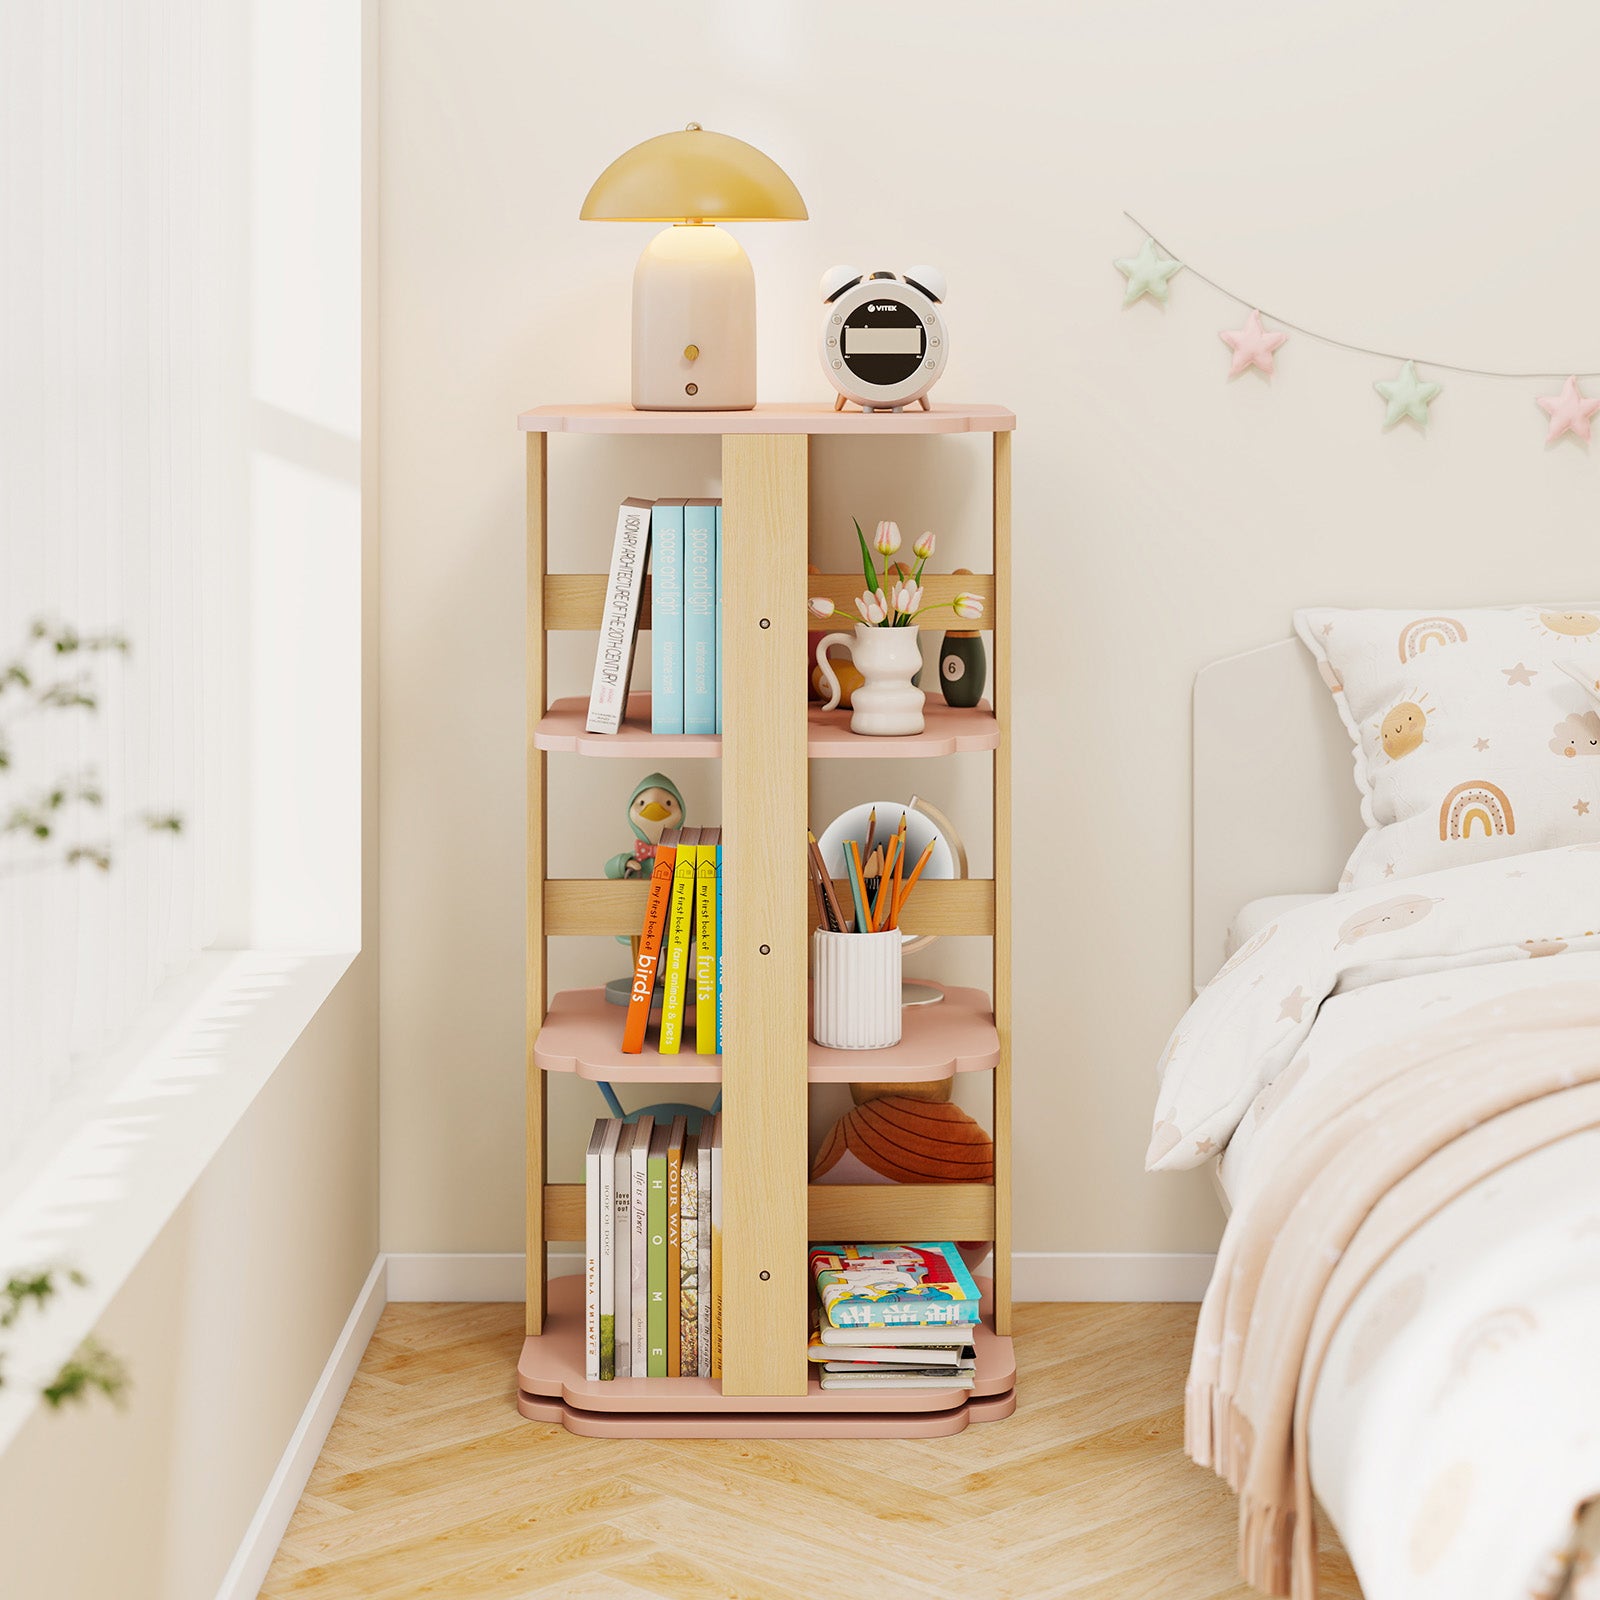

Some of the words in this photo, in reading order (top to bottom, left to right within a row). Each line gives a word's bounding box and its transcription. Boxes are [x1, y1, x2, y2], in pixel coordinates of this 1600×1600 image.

[622, 514, 641, 547] VISIONARY
[657, 528, 676, 563] space
[689, 528, 708, 563] space
[614, 547, 635, 602] ARCHITECTURE
[660, 566, 680, 589] and
[692, 566, 712, 589] and
[612, 601, 629, 612] OF
[656, 592, 680, 616] light
[688, 592, 712, 616] light
[610, 611, 627, 628] THE
[607, 627, 625, 650] 20TH
[601, 648, 622, 687] CENTURY
[948, 662, 956, 674] 6
[652, 885, 661, 897] my
[677, 884, 685, 894] my
[700, 885, 707, 897] my
[650, 899, 660, 918] first
[676, 897, 685, 914] first
[701, 899, 709, 917] first
[647, 921, 656, 939] book
[675, 917, 684, 934] book
[645, 941, 652, 950] of
[675, 936, 681, 944] of
[702, 942, 709, 950] of
[672, 947, 682, 969] farm
[632, 954, 656, 1002] birds
[698, 955, 714, 1001] fruits
[669, 973, 680, 1009] animals
[668, 1012, 676, 1020] &
[665, 1022, 675, 1045] pets
[633, 1171, 645, 1185] life
[670, 1160, 678, 1206] YOUR
[637, 1188, 643, 1196] is
[634, 1207, 645, 1234] flower
[670, 1213, 678, 1247] WAY
[652, 1180, 662, 1356] HOME
[703, 1305, 711, 1322] love
